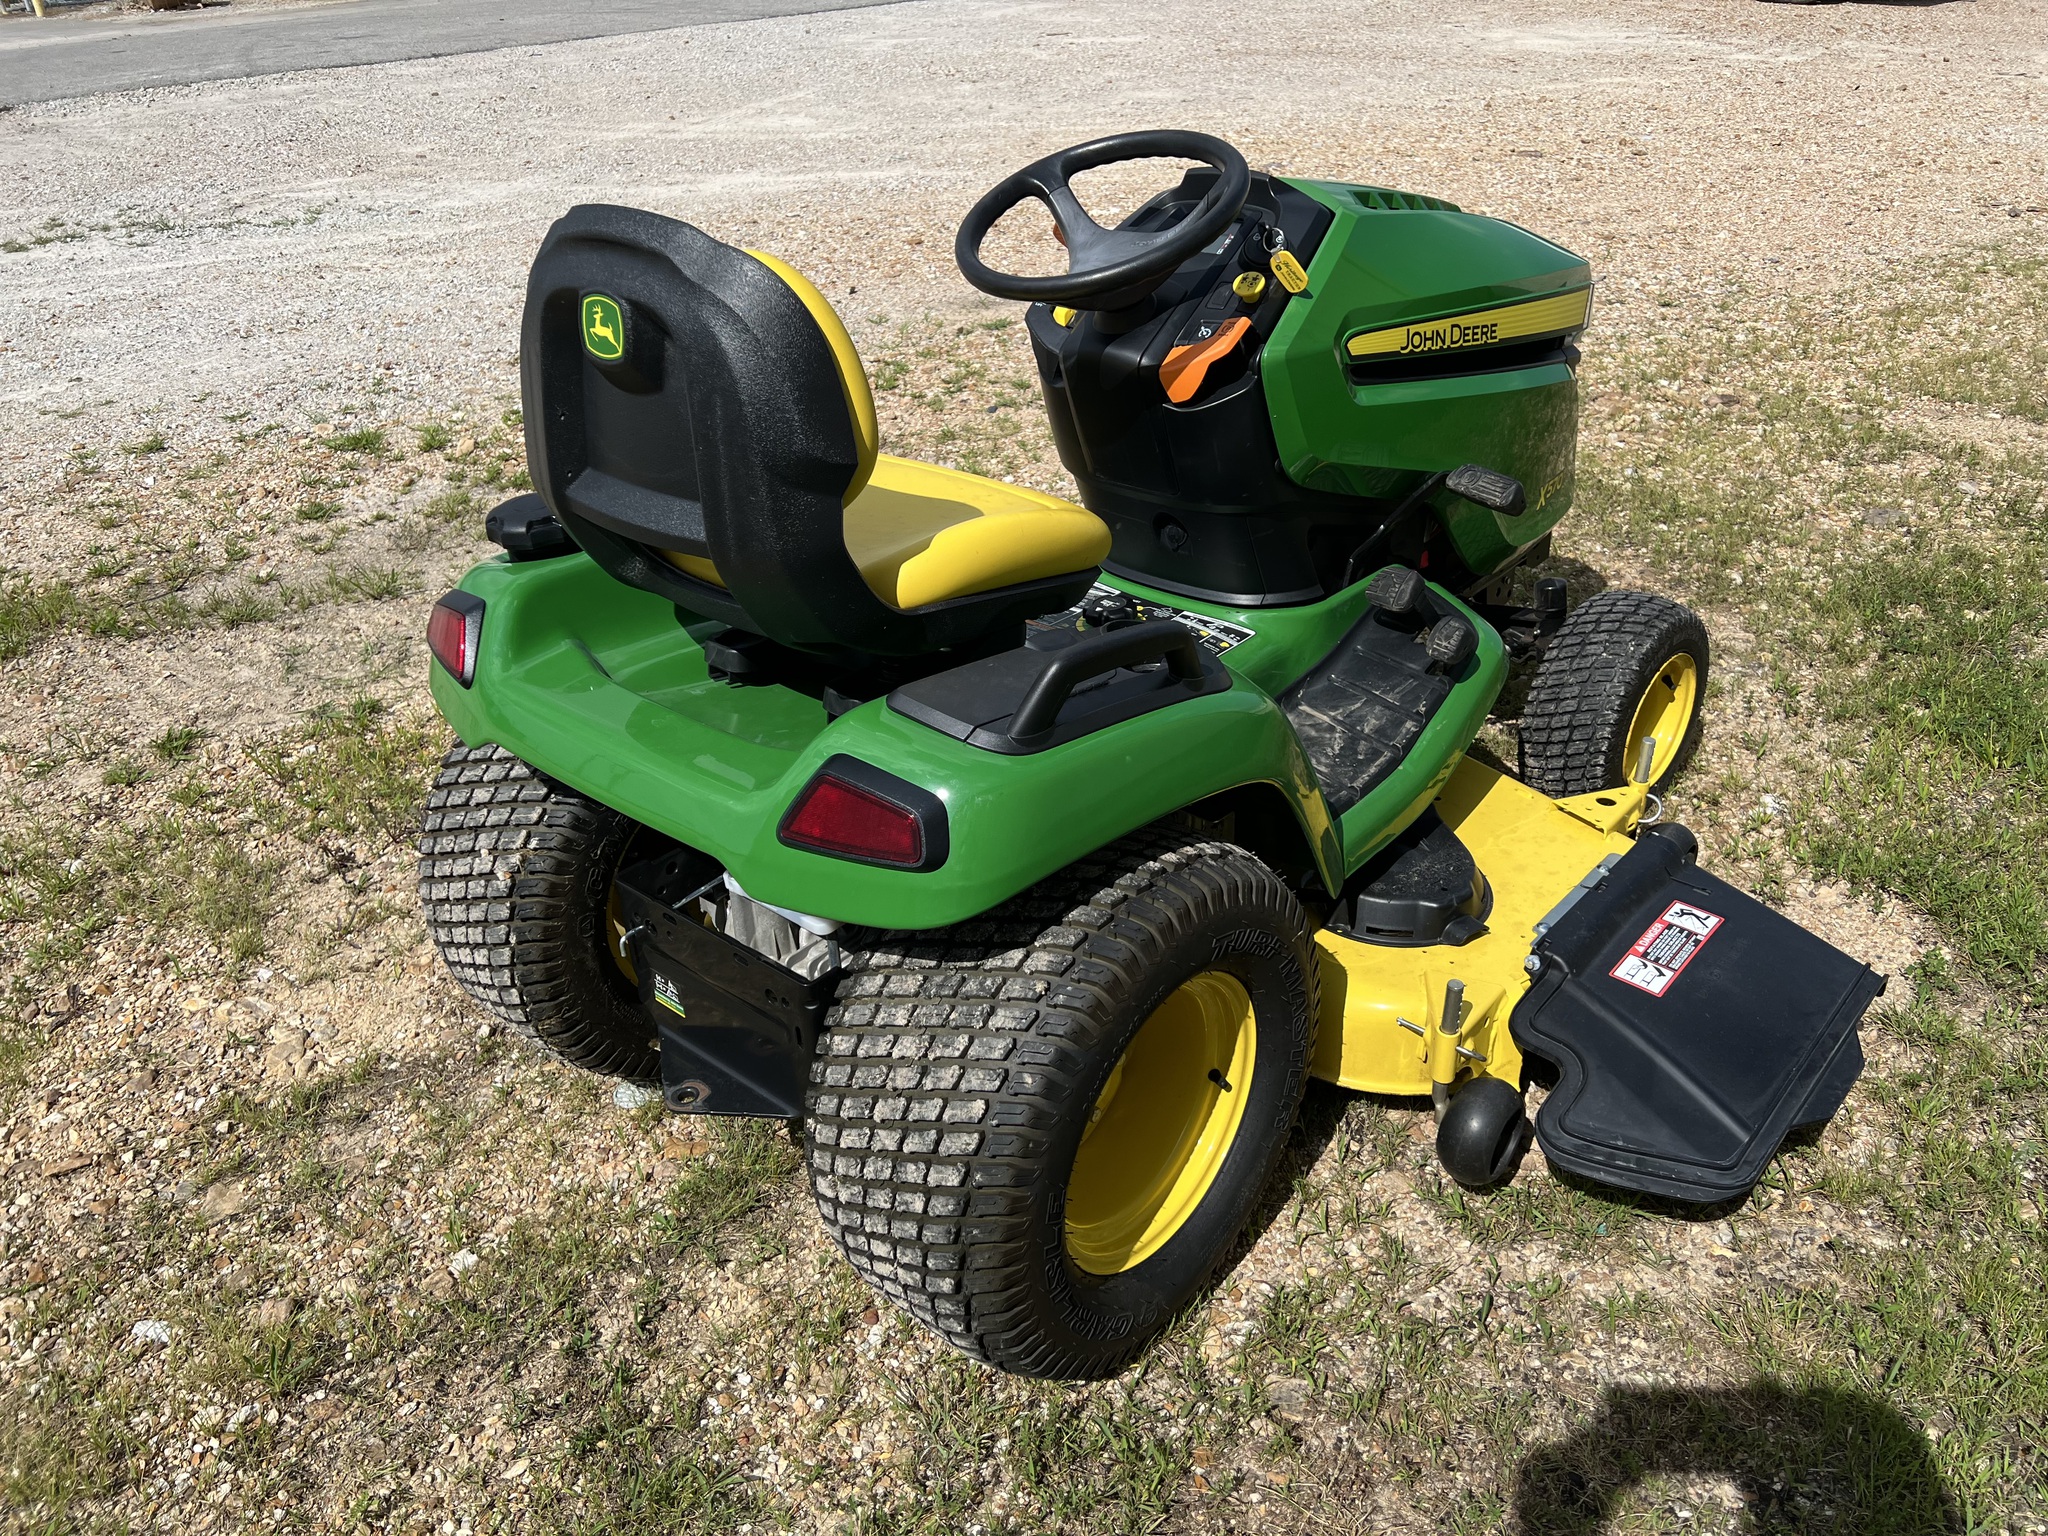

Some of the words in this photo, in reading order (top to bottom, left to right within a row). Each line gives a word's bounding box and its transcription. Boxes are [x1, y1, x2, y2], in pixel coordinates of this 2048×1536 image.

[1400, 328, 1447, 353] JOHN
[1450, 323, 1499, 347] DEERE
[1639, 922, 1665, 947] DANGER
[1211, 928, 1287, 961] TURF
[1273, 954, 1310, 1133] MASTER
[1043, 1188, 1134, 1341] CARLISLE
